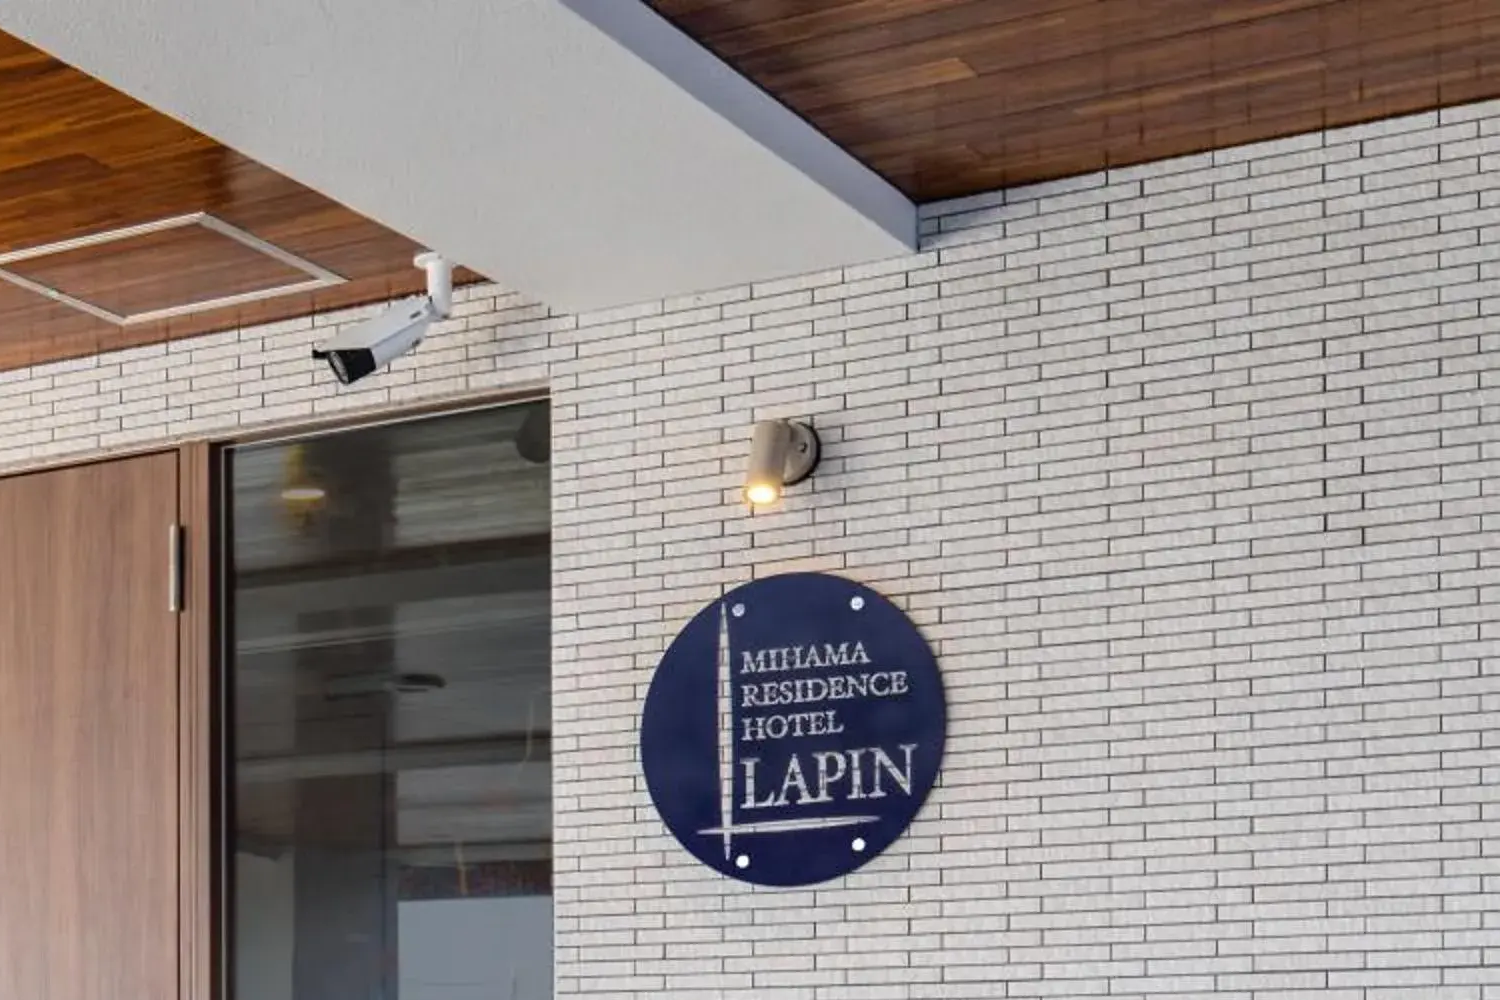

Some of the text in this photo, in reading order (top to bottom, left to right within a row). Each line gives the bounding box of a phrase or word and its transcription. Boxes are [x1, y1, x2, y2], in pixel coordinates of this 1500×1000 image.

[740, 641, 871, 674] MIHAMA
[740, 671, 909, 707] RESIDENCE
[740, 710, 845, 741] HOTEL
[740, 743, 918, 809] LAPIN
